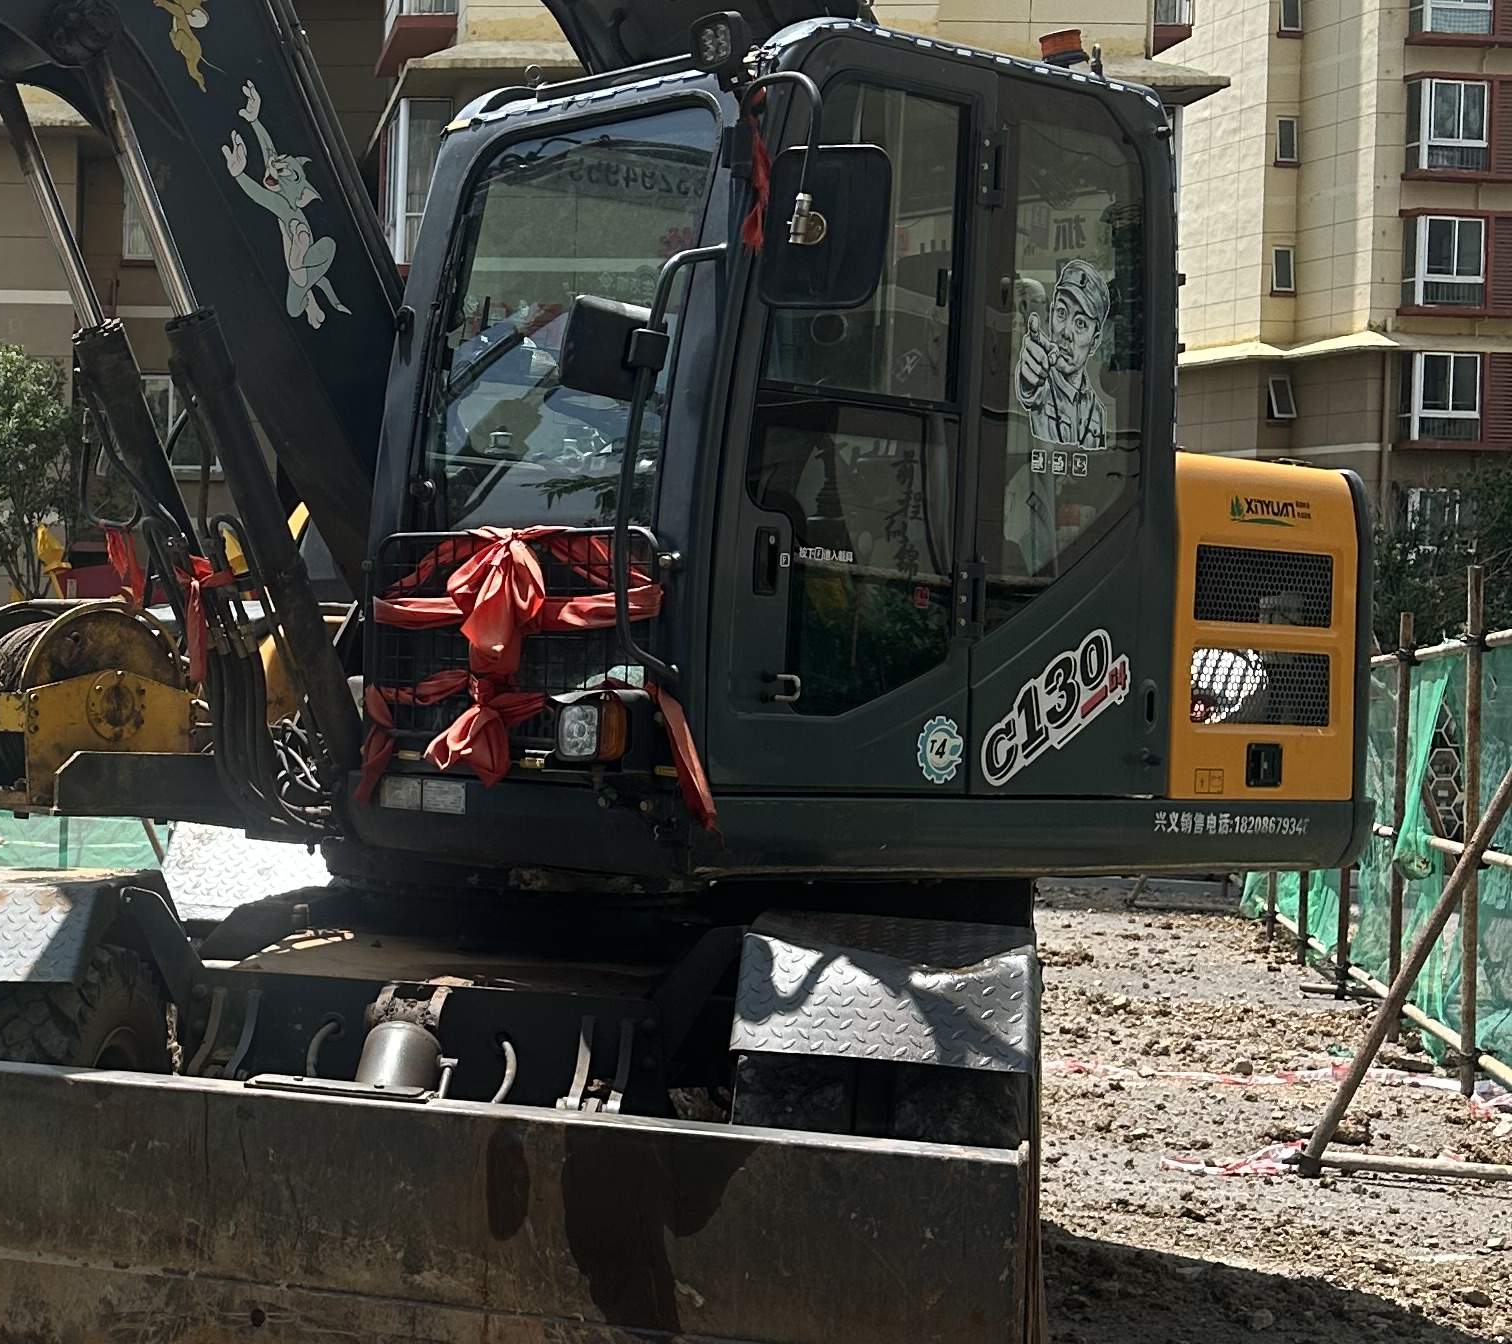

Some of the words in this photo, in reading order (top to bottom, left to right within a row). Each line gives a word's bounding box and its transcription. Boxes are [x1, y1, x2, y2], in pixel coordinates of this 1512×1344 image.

[1244, 497, 1296, 519] XINYUAN
[984, 632, 1110, 783] C130
[929, 738, 948, 759] T4
